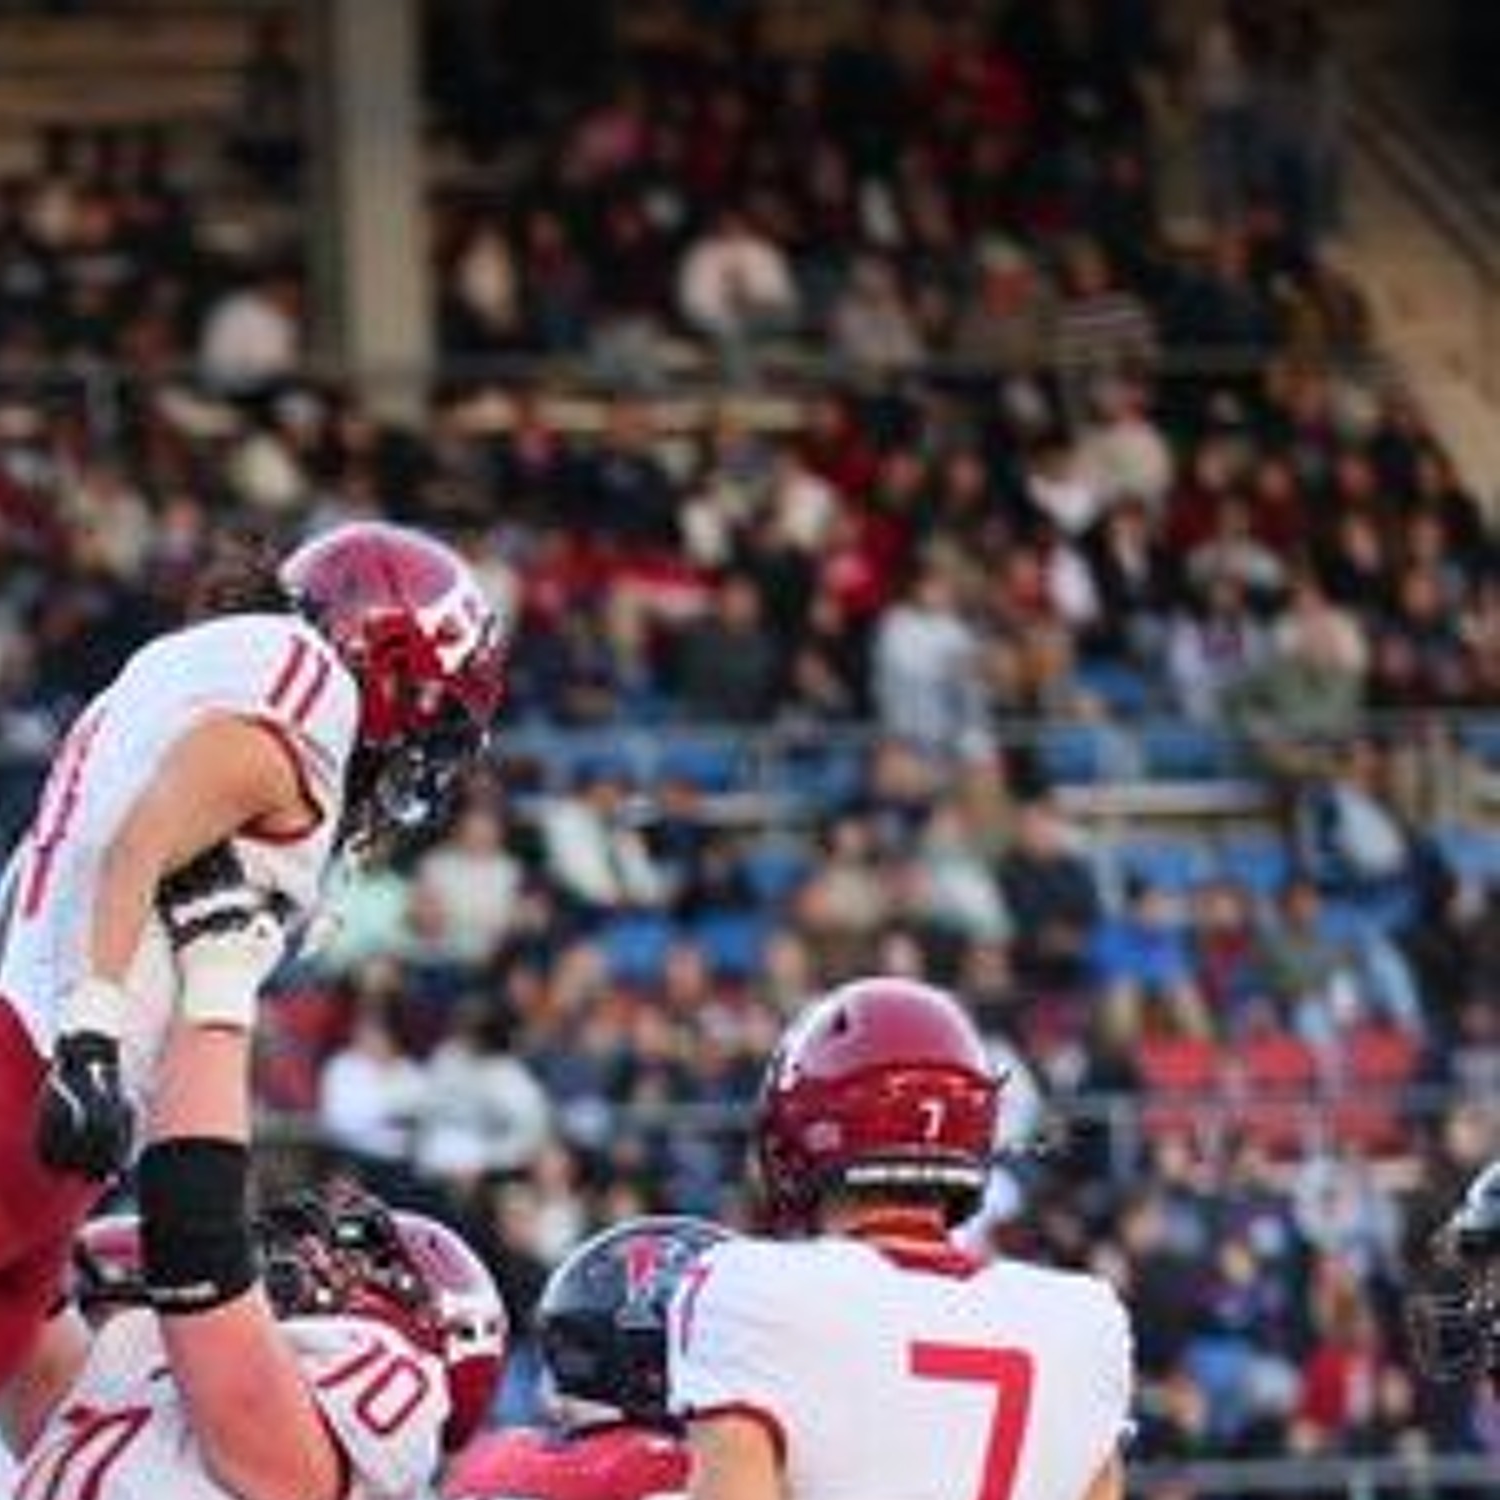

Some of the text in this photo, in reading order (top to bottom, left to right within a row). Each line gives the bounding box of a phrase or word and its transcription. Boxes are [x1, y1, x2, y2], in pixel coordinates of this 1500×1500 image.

[265, 634, 333, 725] 11
[917, 1099, 947, 1139] 7
[317, 1341, 431, 1436] 70
